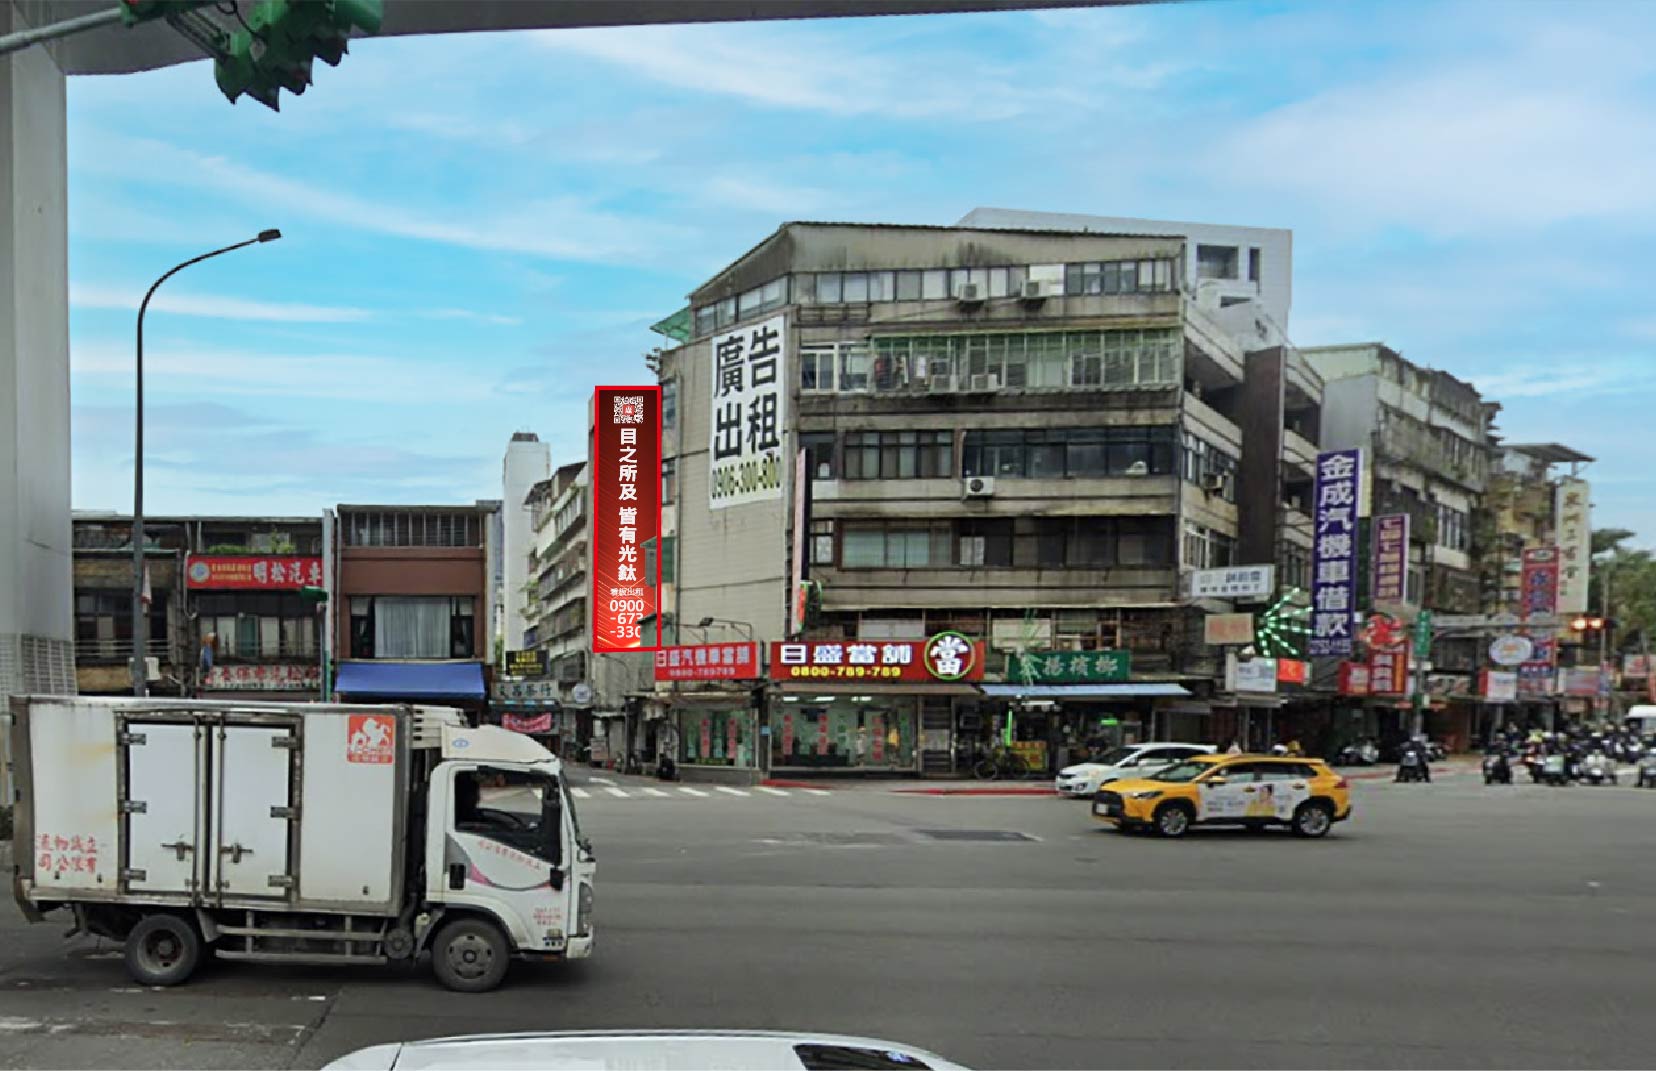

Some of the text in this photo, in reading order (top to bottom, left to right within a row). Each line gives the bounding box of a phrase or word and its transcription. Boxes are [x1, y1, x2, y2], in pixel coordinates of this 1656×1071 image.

[714, 325, 780, 397] 廣告
[714, 392, 780, 461] 出租
[617, 428, 638, 581] 目之所及 皆有光鈦
[609, 599, 645, 612] 0900
